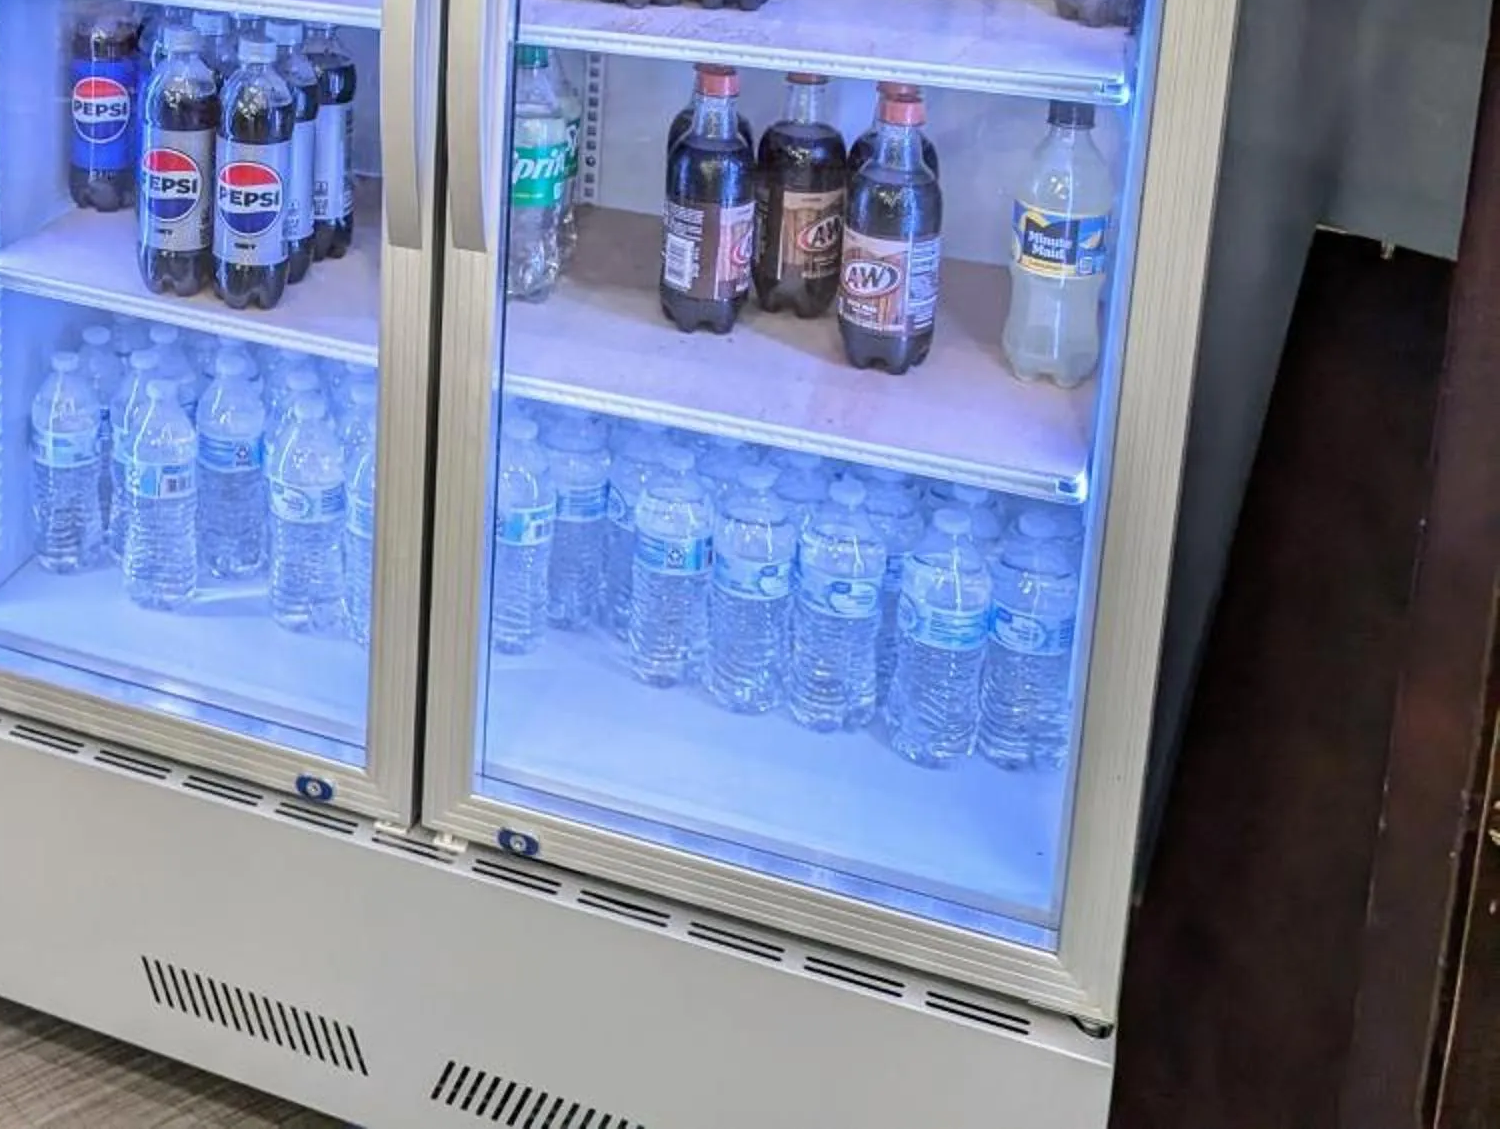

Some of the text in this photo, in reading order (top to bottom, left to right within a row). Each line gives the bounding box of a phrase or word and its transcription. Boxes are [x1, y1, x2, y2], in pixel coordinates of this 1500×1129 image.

[74, 100, 128, 118] PEPSI
[512, 148, 566, 185] prit
[143, 172, 198, 194] EPSI
[219, 186, 280, 207] PEPSI
